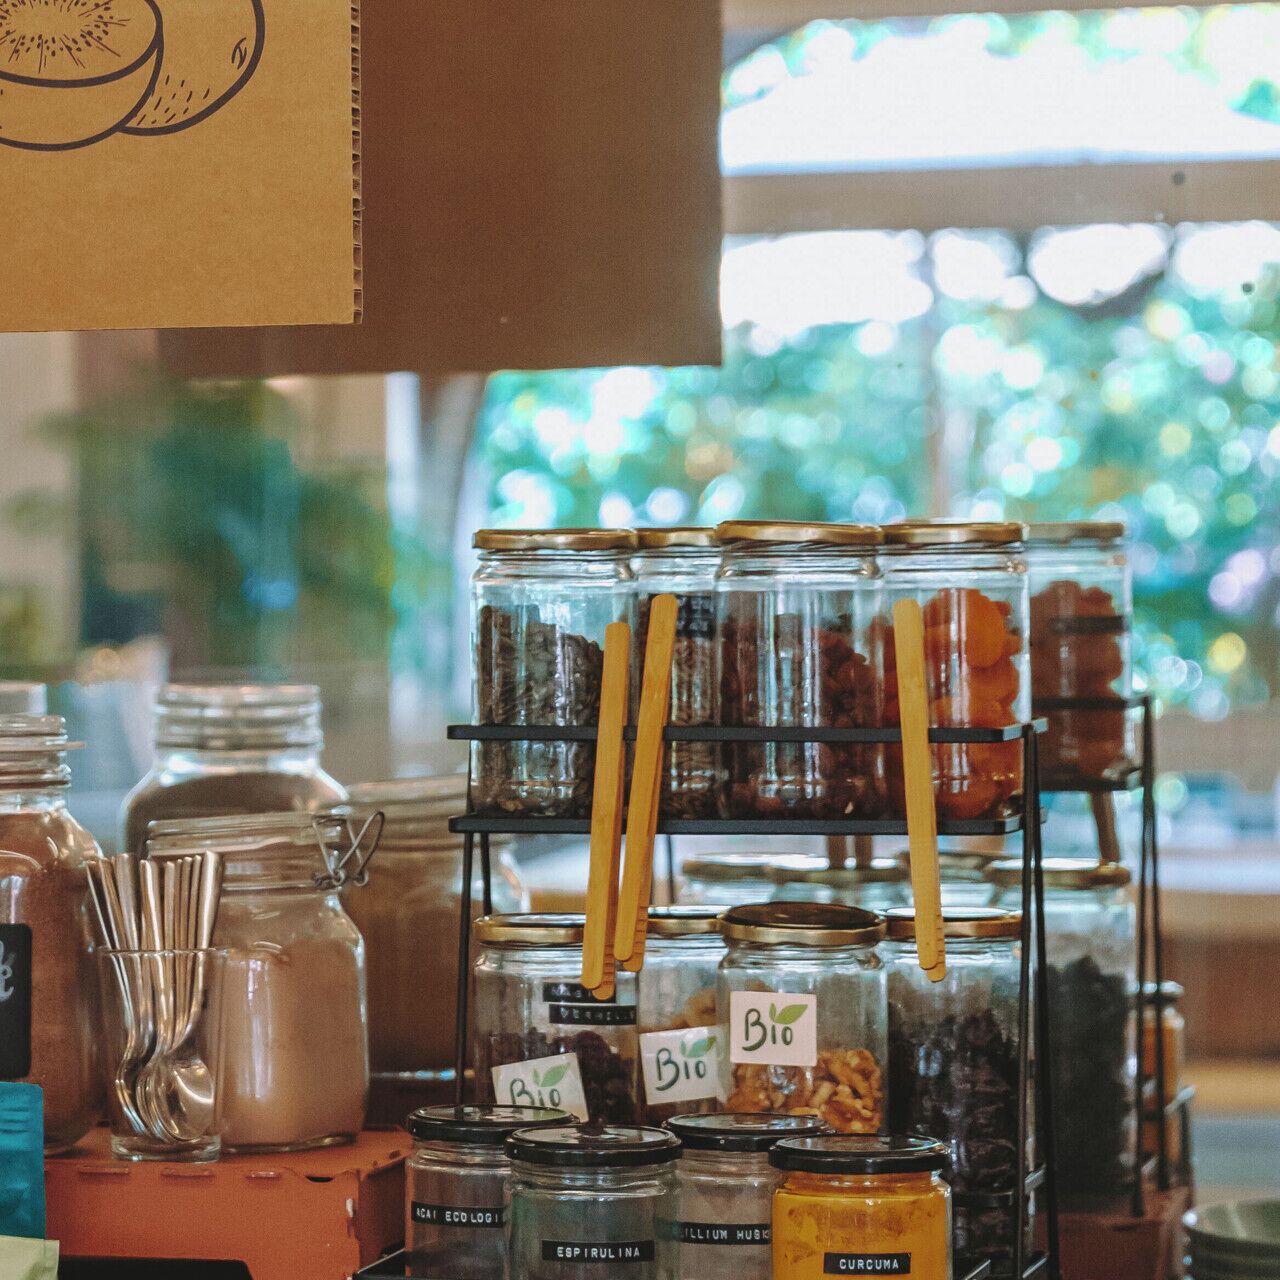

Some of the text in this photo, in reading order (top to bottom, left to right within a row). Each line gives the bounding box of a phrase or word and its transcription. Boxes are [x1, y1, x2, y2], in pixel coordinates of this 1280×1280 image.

[742, 1008, 793, 1052] Bio
[655, 1047, 706, 1092] Bio
[445, 1211, 501, 1223] ECOLOGI
[684, 1229, 728, 1240] ILLIUM
[556, 1246, 640, 1259] ESPIRULINA
[839, 1258, 900, 1270] CURCUMA
